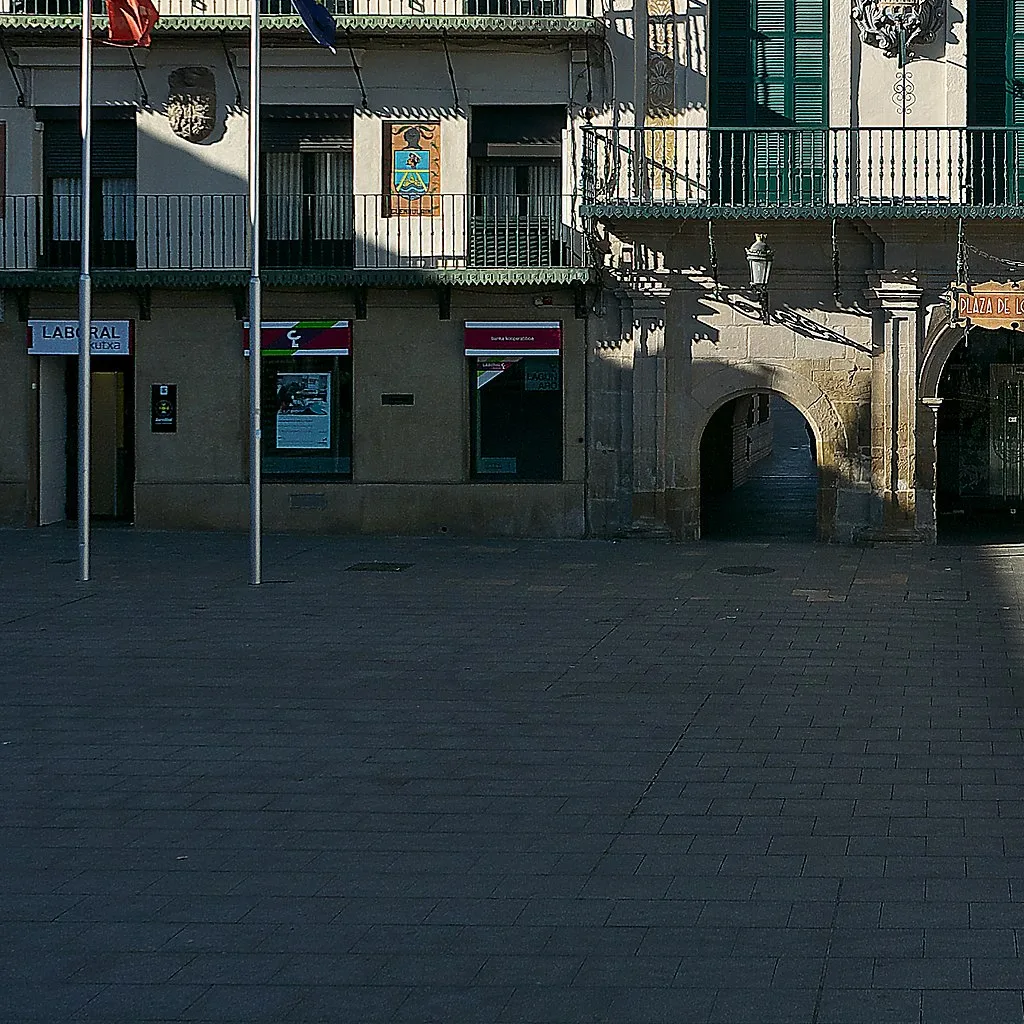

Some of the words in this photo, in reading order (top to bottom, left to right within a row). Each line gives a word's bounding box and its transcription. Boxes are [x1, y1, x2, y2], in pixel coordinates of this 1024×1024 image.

[960, 297, 993, 314] PLAZA
[997, 297, 1011, 315] DE
[42, 326, 121, 339] LABRAL
